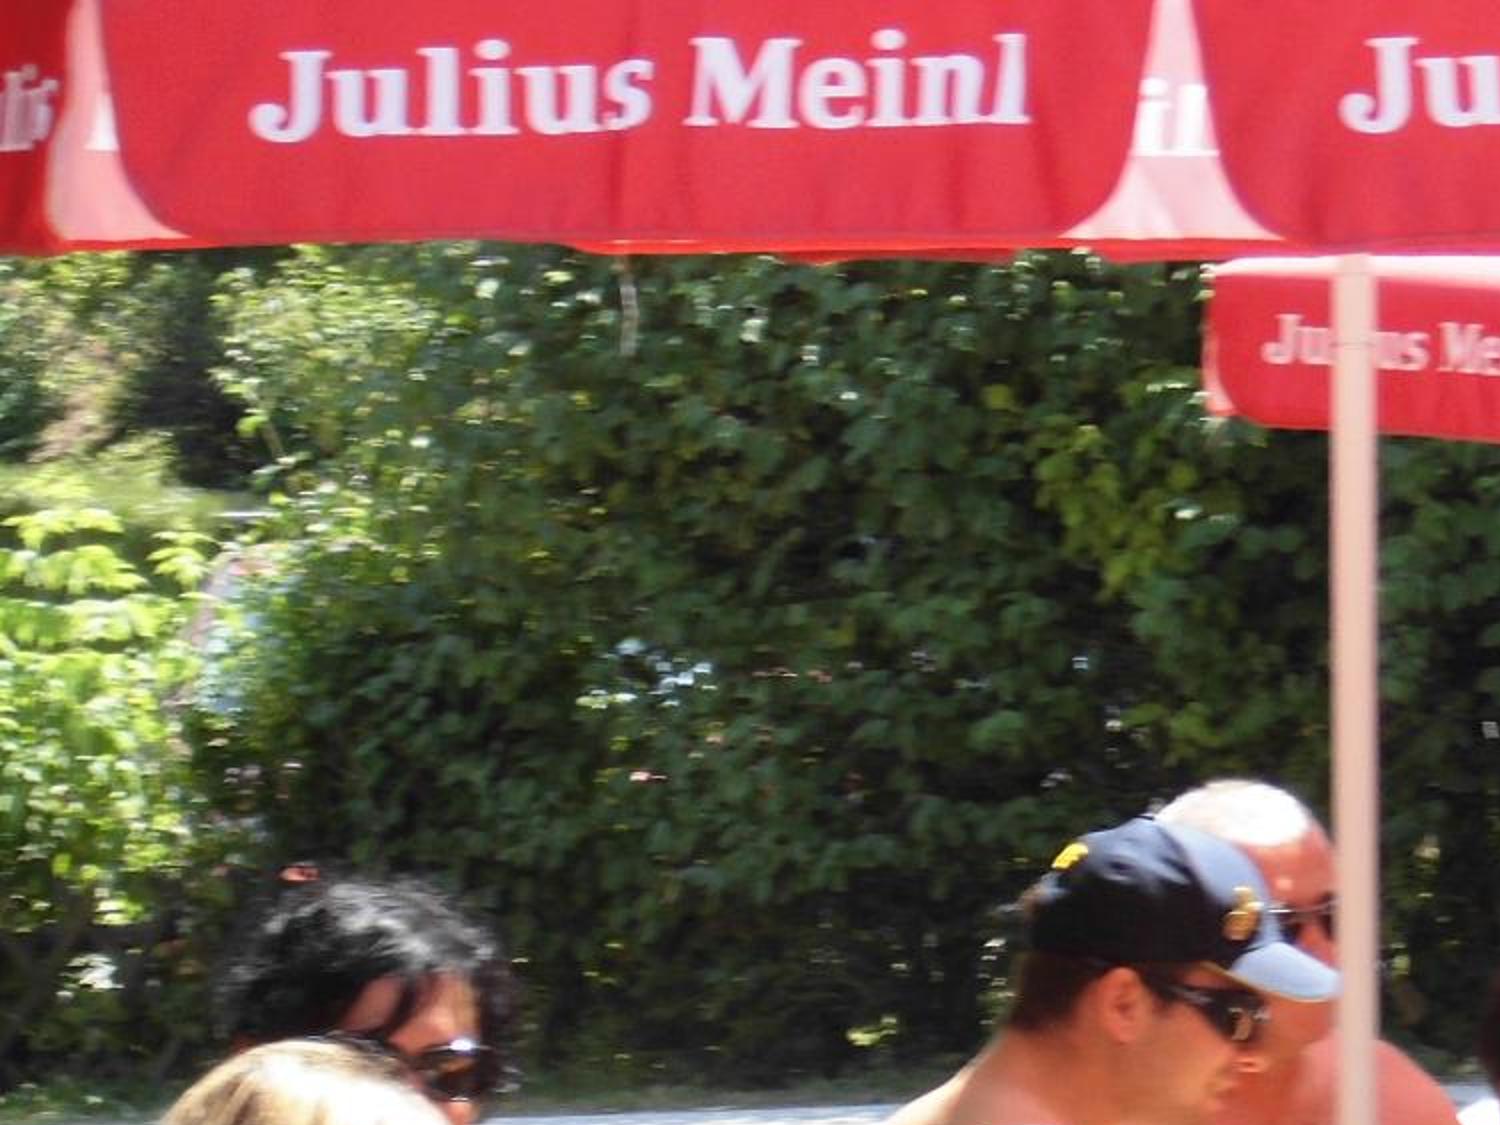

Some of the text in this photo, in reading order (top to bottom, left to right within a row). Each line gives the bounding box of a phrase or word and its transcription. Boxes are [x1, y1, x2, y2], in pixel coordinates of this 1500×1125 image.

[248, 39, 652, 144] Julius
[682, 30, 1031, 131] Meinl
[1261, 312, 1430, 372] Juus
